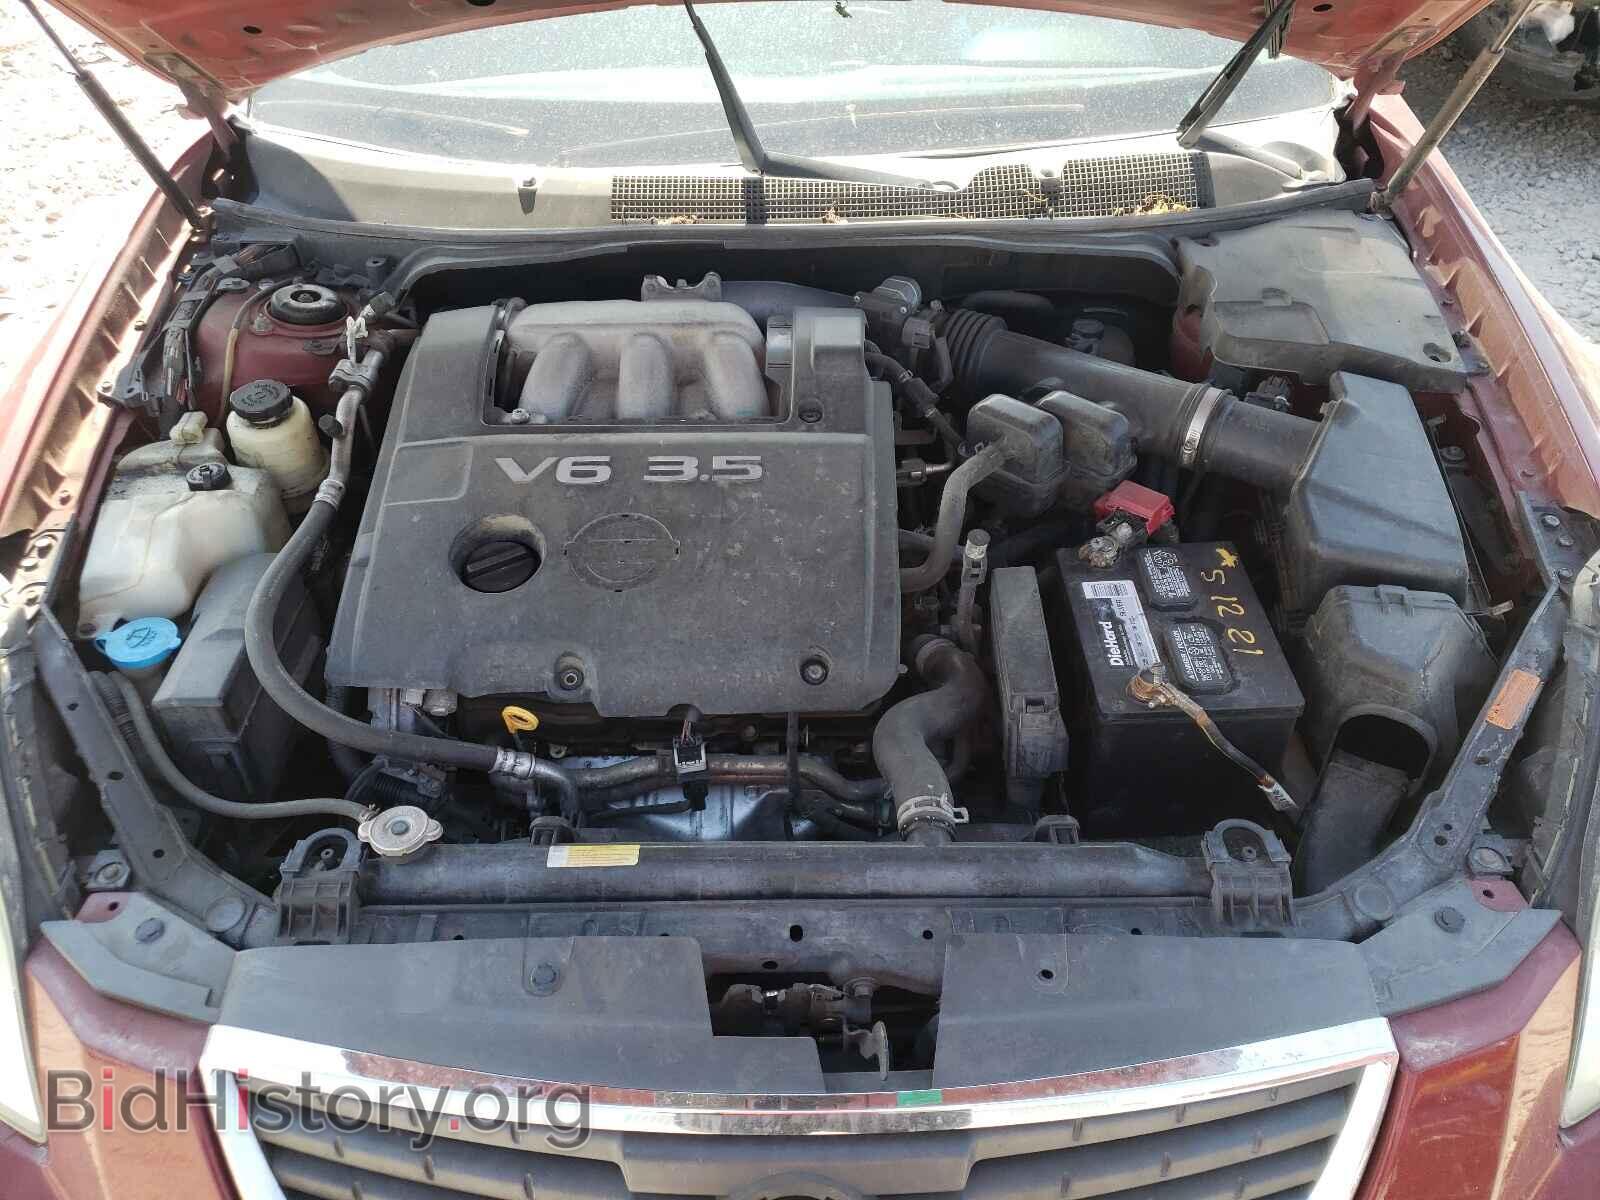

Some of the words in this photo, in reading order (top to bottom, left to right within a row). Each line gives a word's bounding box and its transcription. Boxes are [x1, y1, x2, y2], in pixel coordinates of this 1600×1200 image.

[495, 456, 612, 484] V6
[643, 455, 763, 482] 3.5
[1098, 621, 1125, 666] DieHard
